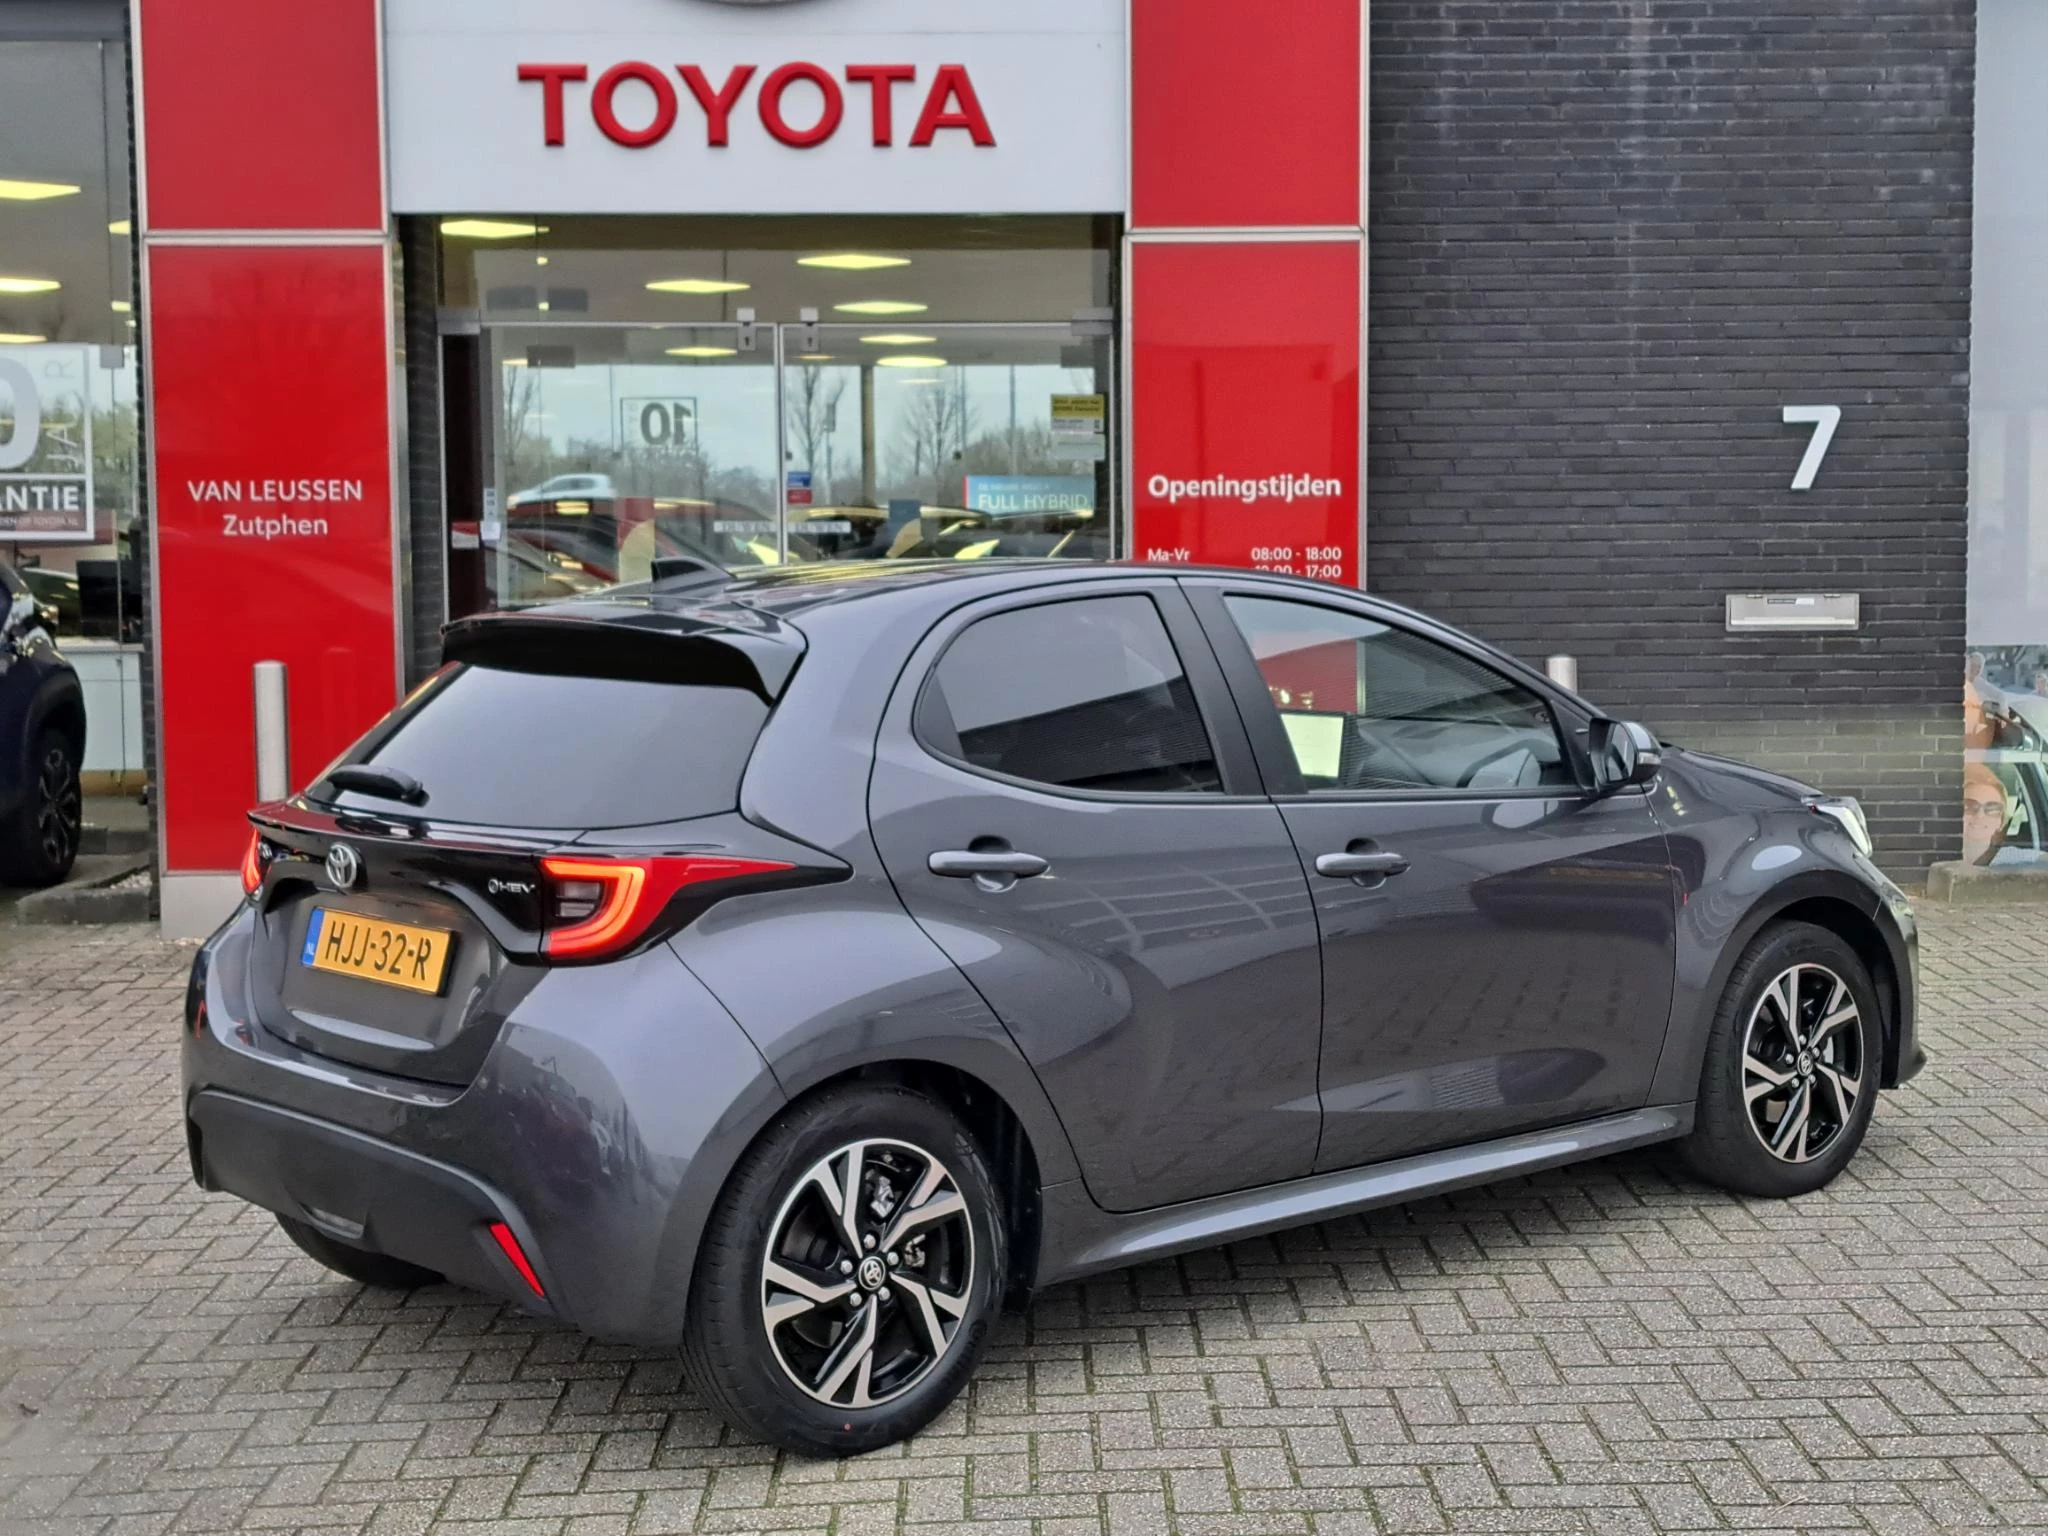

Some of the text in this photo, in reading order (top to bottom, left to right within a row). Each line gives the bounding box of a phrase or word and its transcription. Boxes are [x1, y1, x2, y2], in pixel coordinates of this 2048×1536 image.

[517, 61, 997, 148] TOYOTA
[1783, 405, 1841, 490] 7
[0, 485, 80, 511] NTIE
[187, 480, 363, 502] VAN LEUSSEN
[979, 494, 1088, 510] FULL HYBRID
[1148, 474, 1343, 504] Openingstijden
[222, 513, 329, 540] Zutphen
[1147, 547, 1190, 561] Ma-Vr
[1251, 547, 1292, 561] 08:00
[1305, 547, 1342, 561] 18:00
[1305, 564, 1342, 578] 17:00
[325, 919, 432, 981] HJJ-32-R
